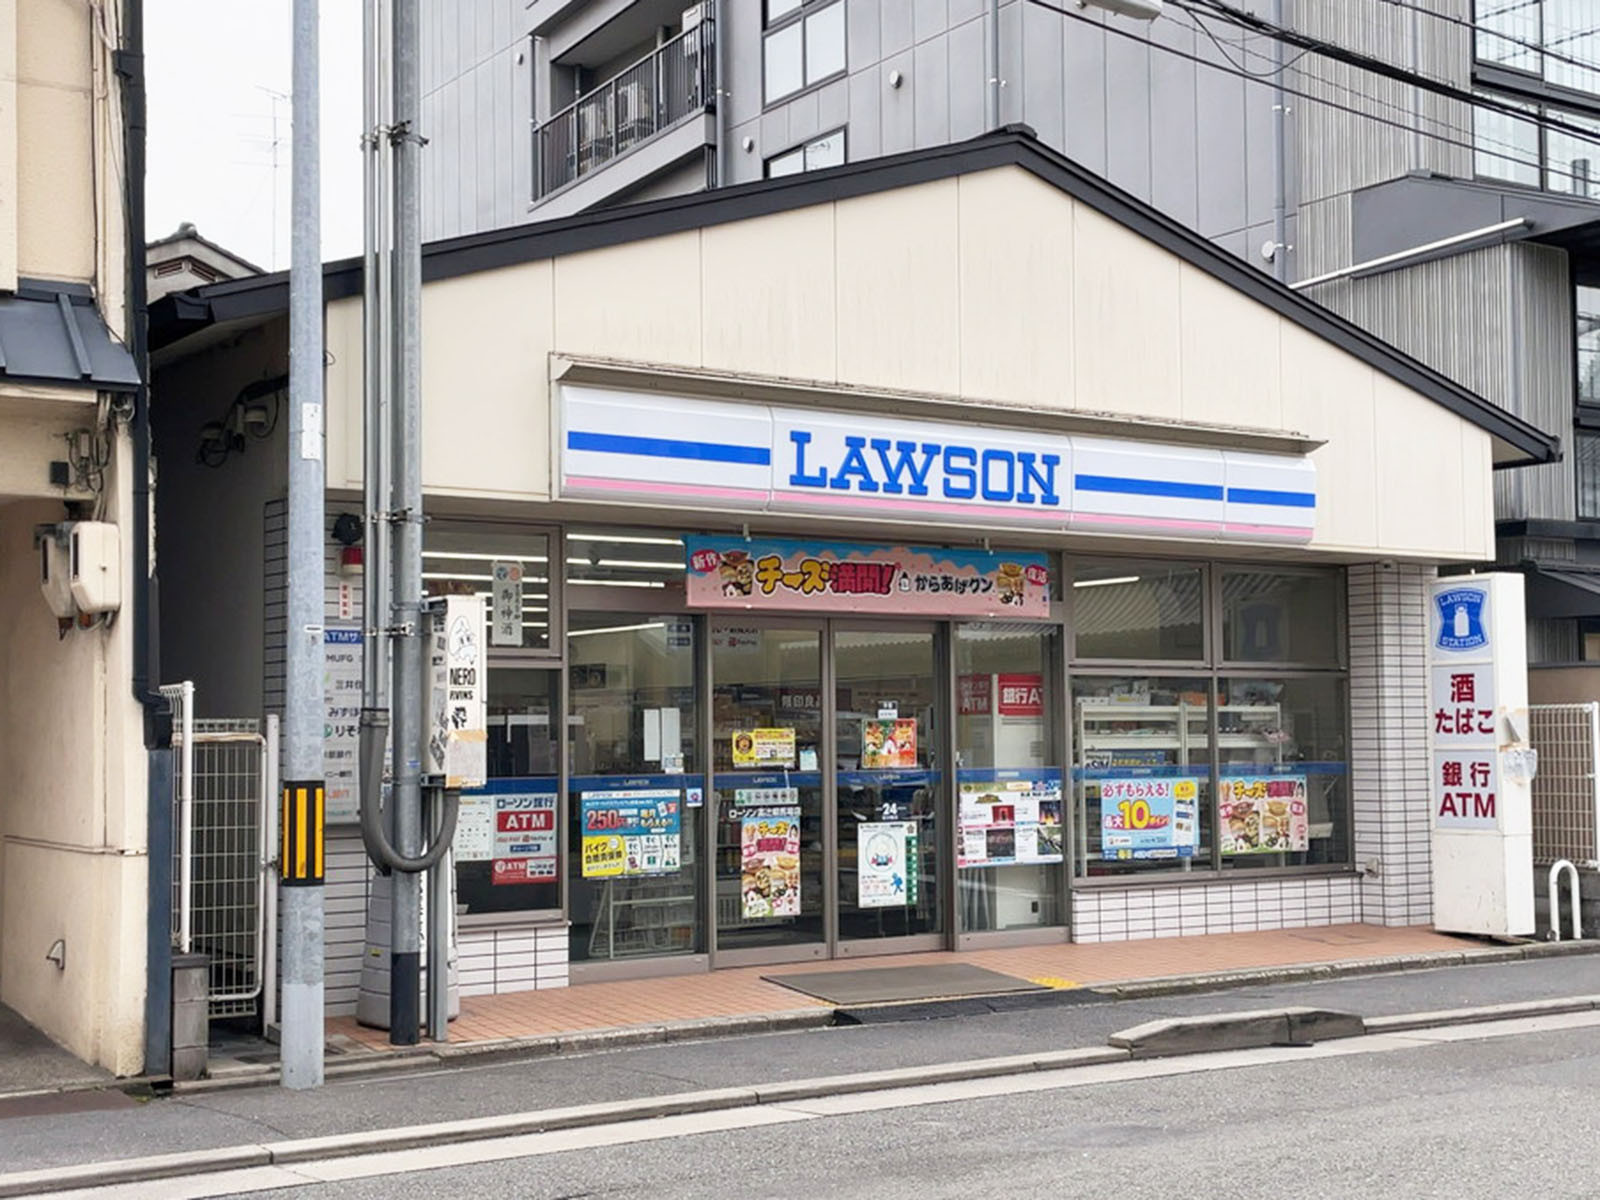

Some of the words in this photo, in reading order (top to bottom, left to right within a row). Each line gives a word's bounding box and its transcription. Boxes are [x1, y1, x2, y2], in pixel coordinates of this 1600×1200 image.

[790, 430, 1060, 505] LAWSON
[914, 574, 992, 594] からあげクン
[1440, 592, 1482, 606] LAWSON
[1441, 633, 1484, 647] STATION
[326, 654, 353, 662] MUFG
[449, 668, 476, 685] NERO
[1450, 673, 1475, 703] 酒
[1434, 708, 1495, 734] たばこ
[1441, 761, 1491, 787] 銀行
[1103, 782, 1169, 798] 必ずもらえる!
[497, 798, 554, 809] ローソン銀行
[882, 802, 898, 815] 24
[1438, 792, 1496, 818] ATM
[506, 813, 546, 829] ATM
[585, 842, 608, 853] バイク
